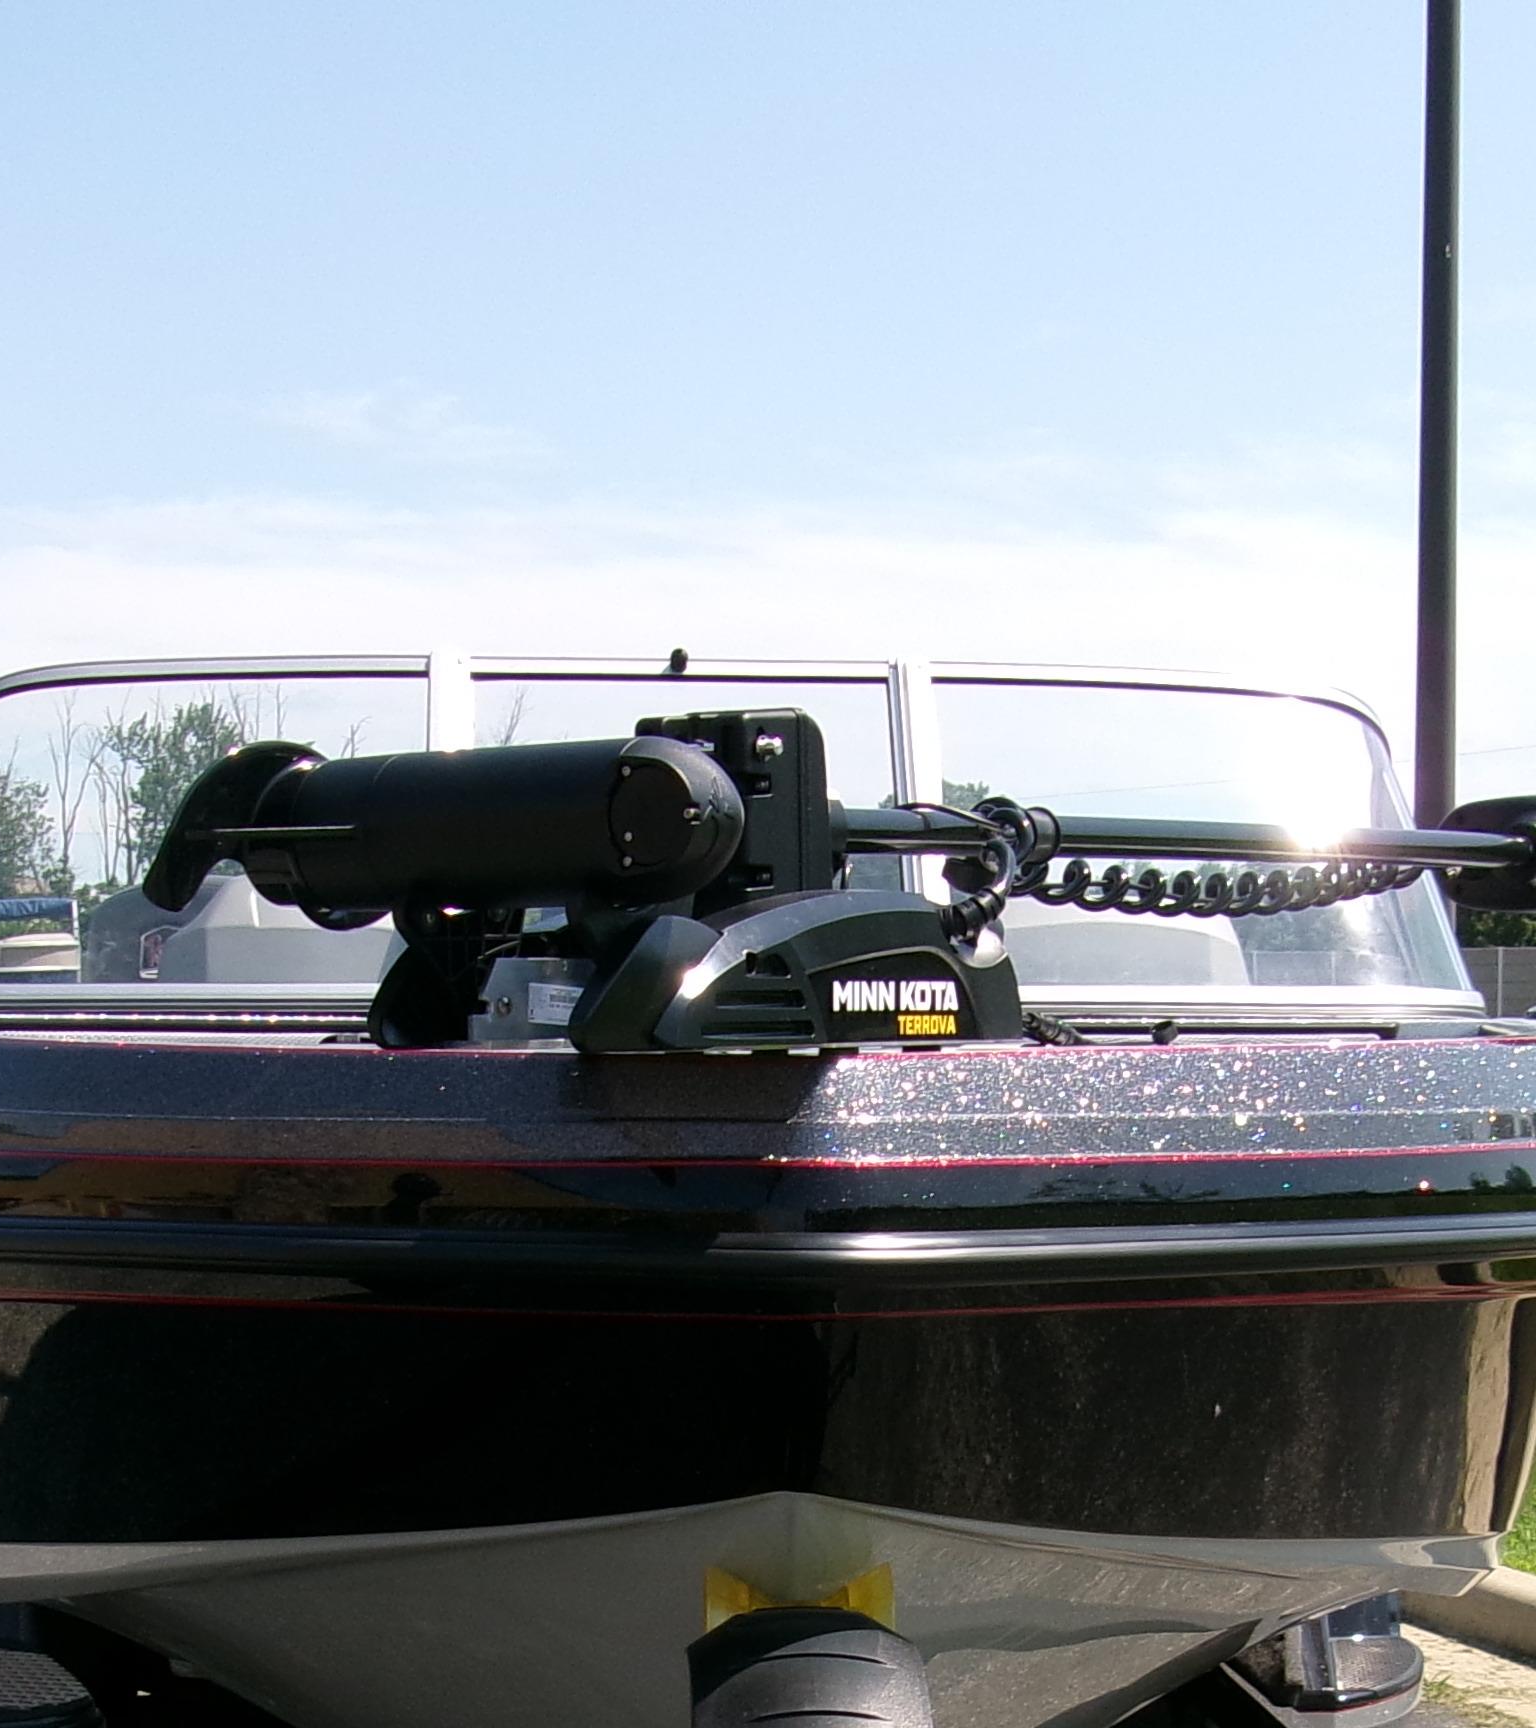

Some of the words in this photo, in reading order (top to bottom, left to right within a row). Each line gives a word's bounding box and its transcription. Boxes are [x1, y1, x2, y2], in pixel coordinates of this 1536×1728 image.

[832, 980, 896, 1012] MINN
[899, 980, 959, 1012] KOTA
[897, 1015, 957, 1035] TERROVA
